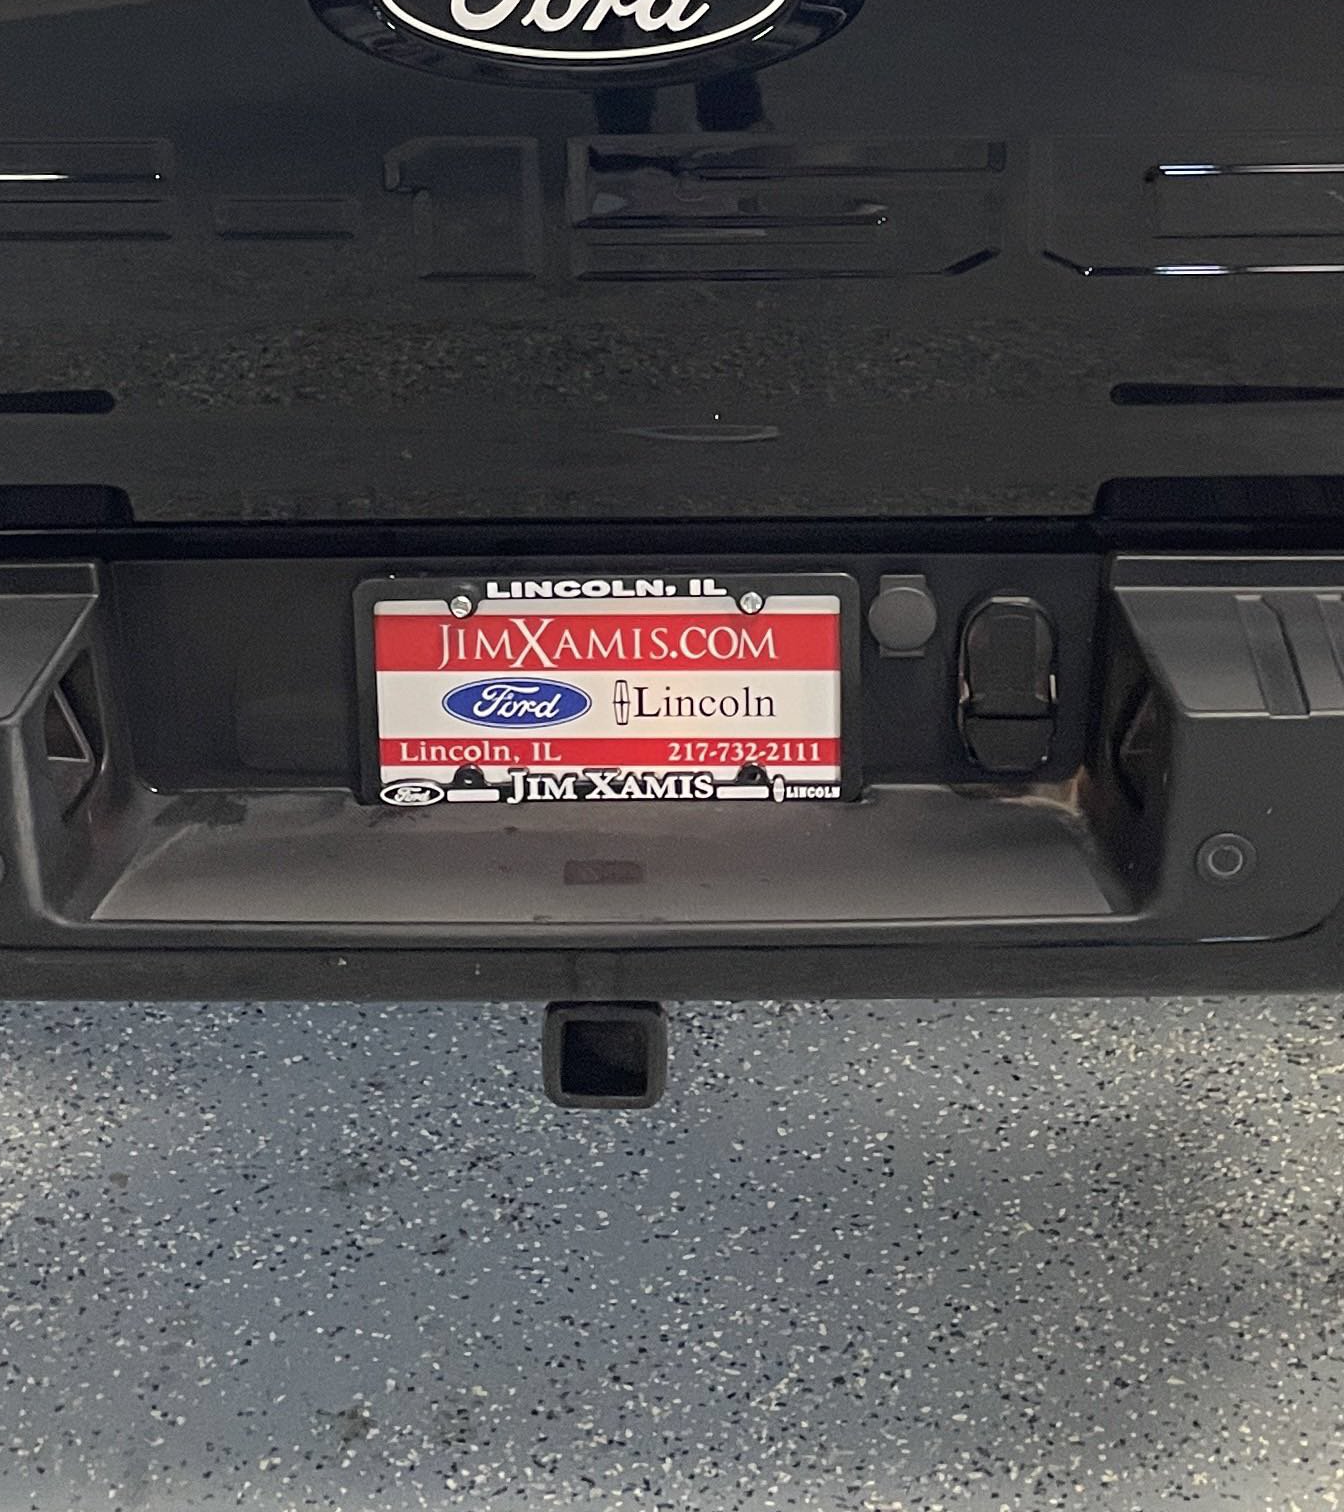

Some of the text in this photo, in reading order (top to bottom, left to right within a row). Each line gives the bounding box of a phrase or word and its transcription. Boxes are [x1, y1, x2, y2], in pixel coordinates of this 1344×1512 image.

[486, 578, 727, 599] LINCOLN, IL
[473, 683, 560, 719] Ford
[633, 686, 776, 718] Lincoln
[400, 741, 562, 763] Lincoln, IL
[668, 742, 821, 762] 217-732-2111
[394, 788, 430, 803] Ford
[506, 770, 714, 804] JIM XAMIS
[786, 786, 841, 799] LINCOLN
